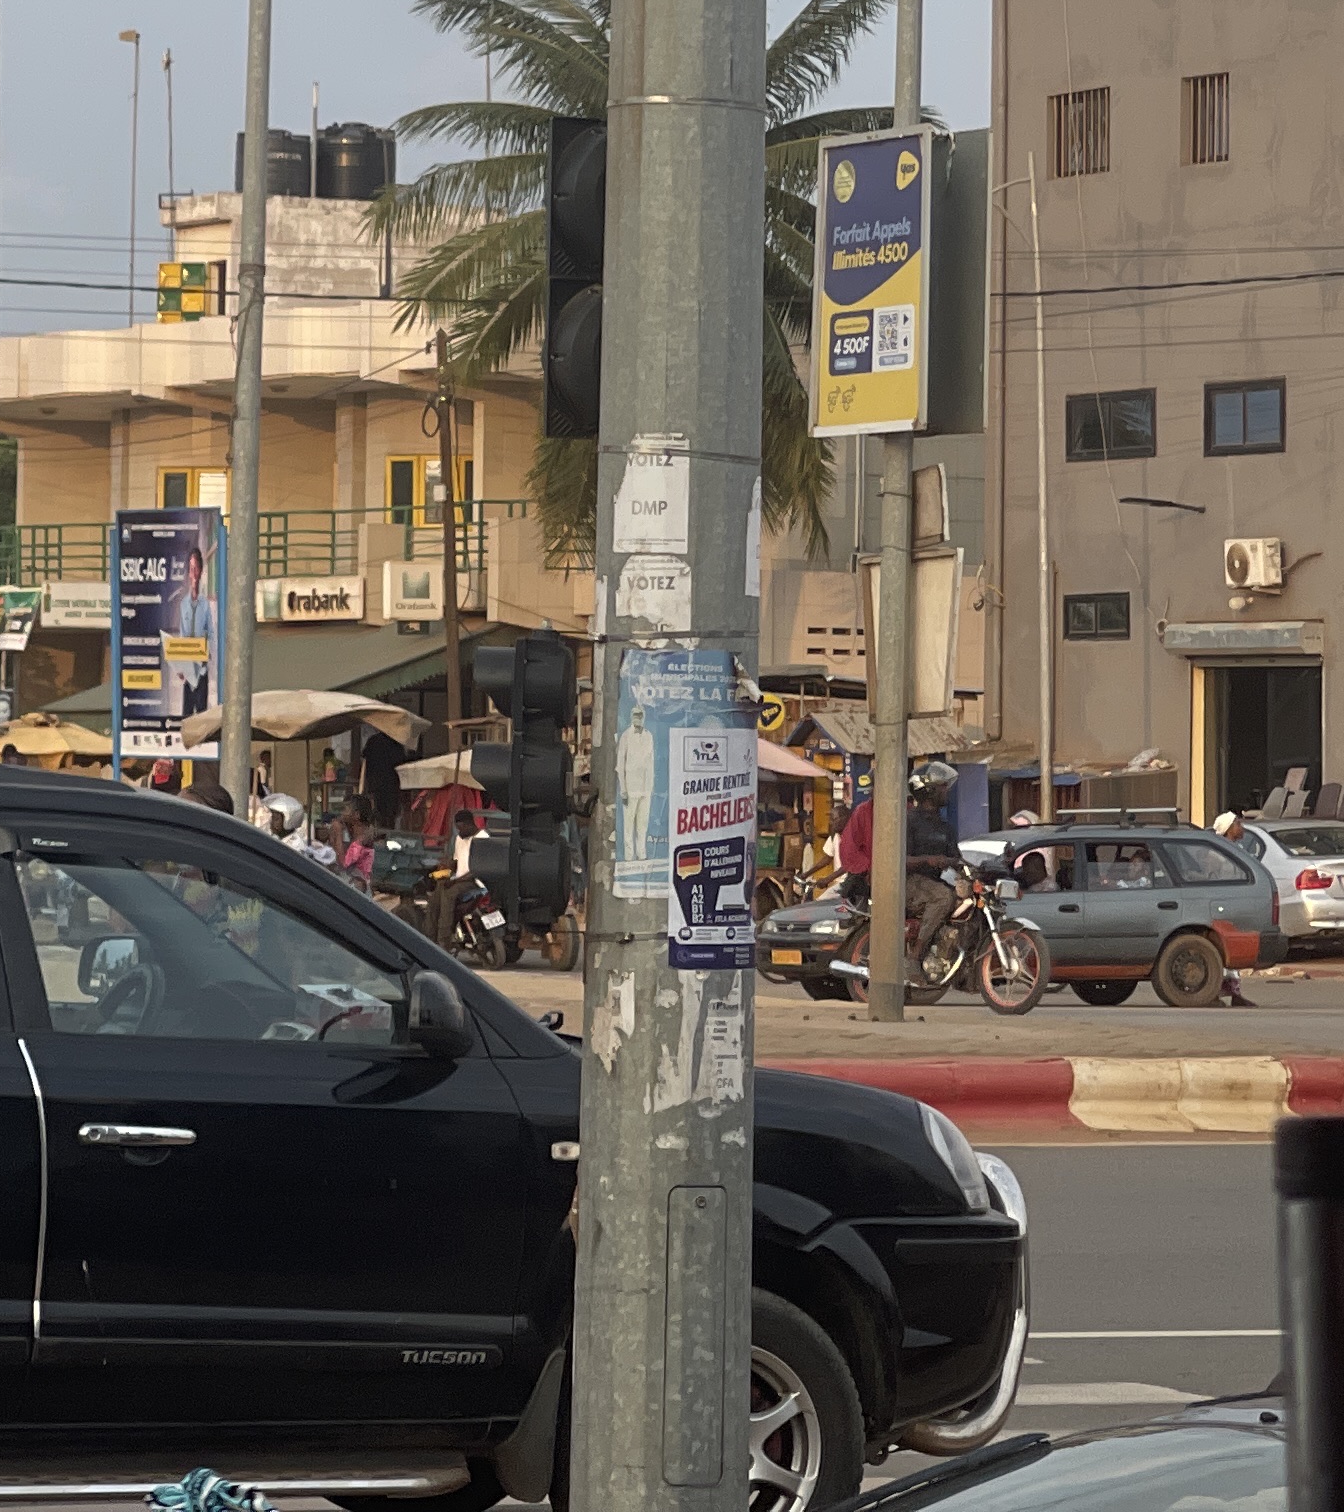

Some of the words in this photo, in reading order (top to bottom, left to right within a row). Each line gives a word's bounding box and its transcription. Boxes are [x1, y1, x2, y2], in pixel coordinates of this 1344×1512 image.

[833, 222, 871, 246] Forfait
[872, 216, 911, 243] Appels
[833, 247, 876, 270] Illimités
[877, 241, 908, 264] 4500
[627, 454, 674, 467] VOTEZ
[632, 501, 668, 515] DMP
[627, 576, 676, 590] VOTEZ
[700, 688, 722, 701] LA
[683, 777, 721, 795] GRANDE
[704, 845, 730, 857] COURS
[691, 884, 703, 894] A1
[691, 895, 704, 904] A2
[692, 905, 703, 913] B1
[692, 914, 704, 923] B2
